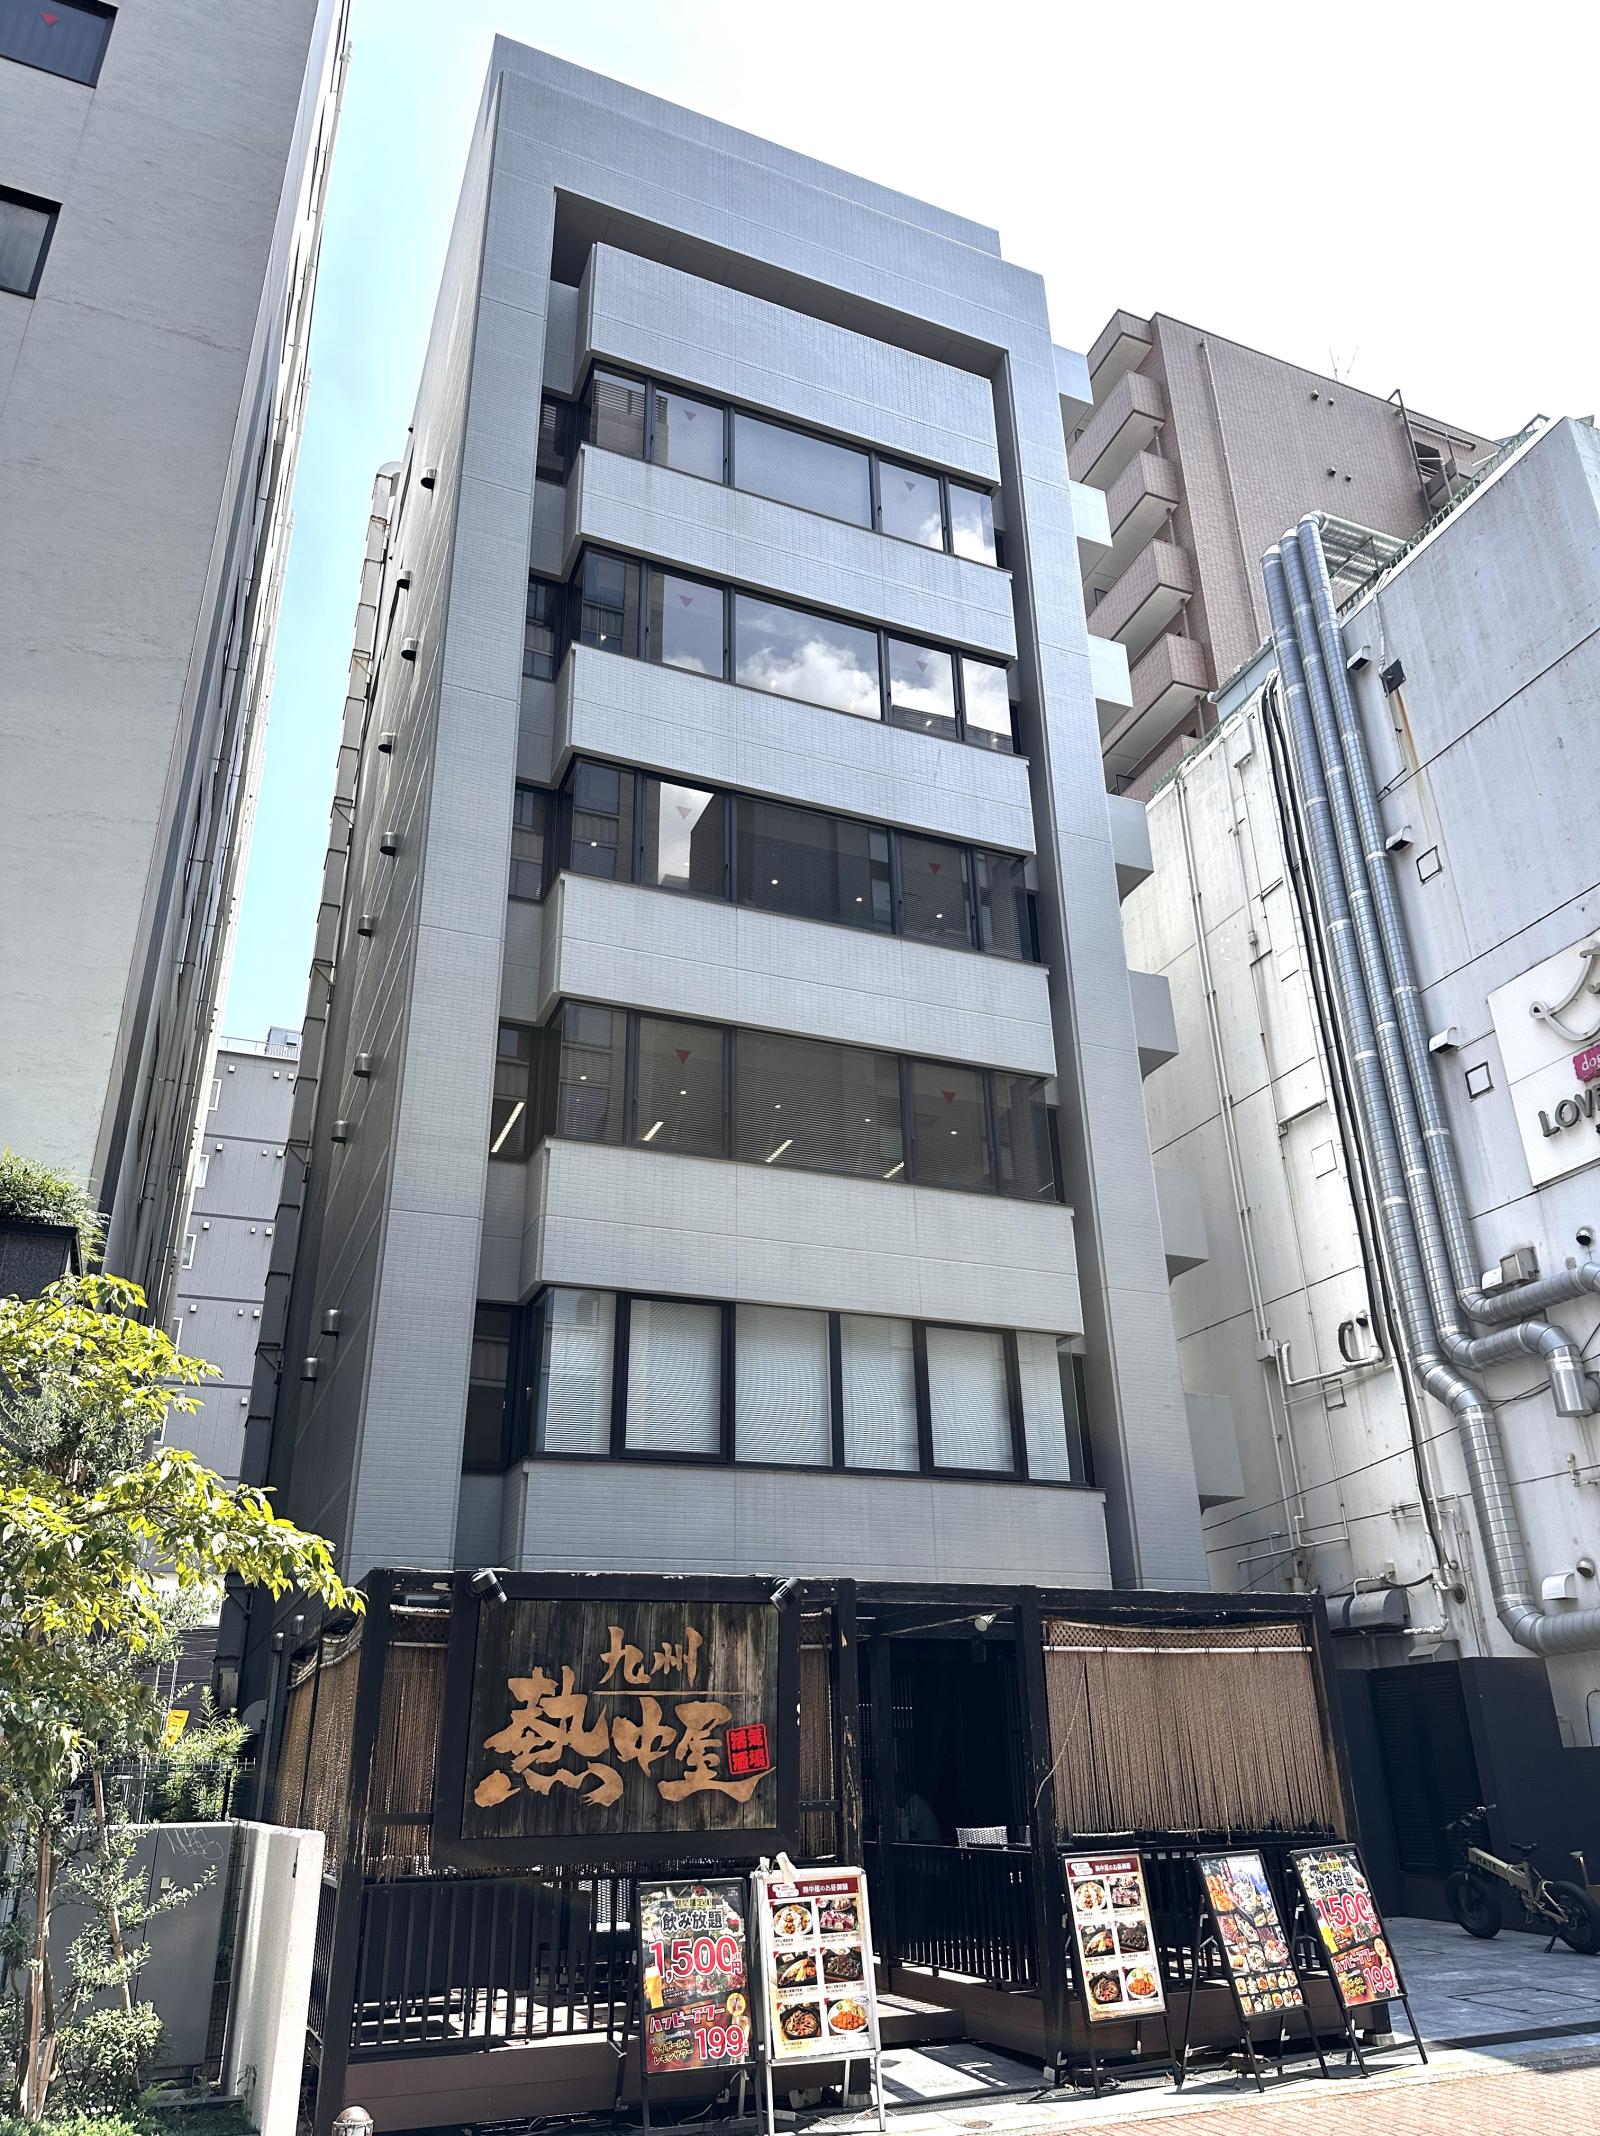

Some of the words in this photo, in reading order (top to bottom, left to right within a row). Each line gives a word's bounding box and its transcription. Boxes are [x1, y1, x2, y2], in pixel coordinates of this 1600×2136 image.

[599, 1626, 703, 1687] 九州
[474, 1665, 776, 1808] 熱中屋
[661, 1908, 724, 1932] 飲み放題
[649, 2004, 727, 2034] ハッピーアワー
